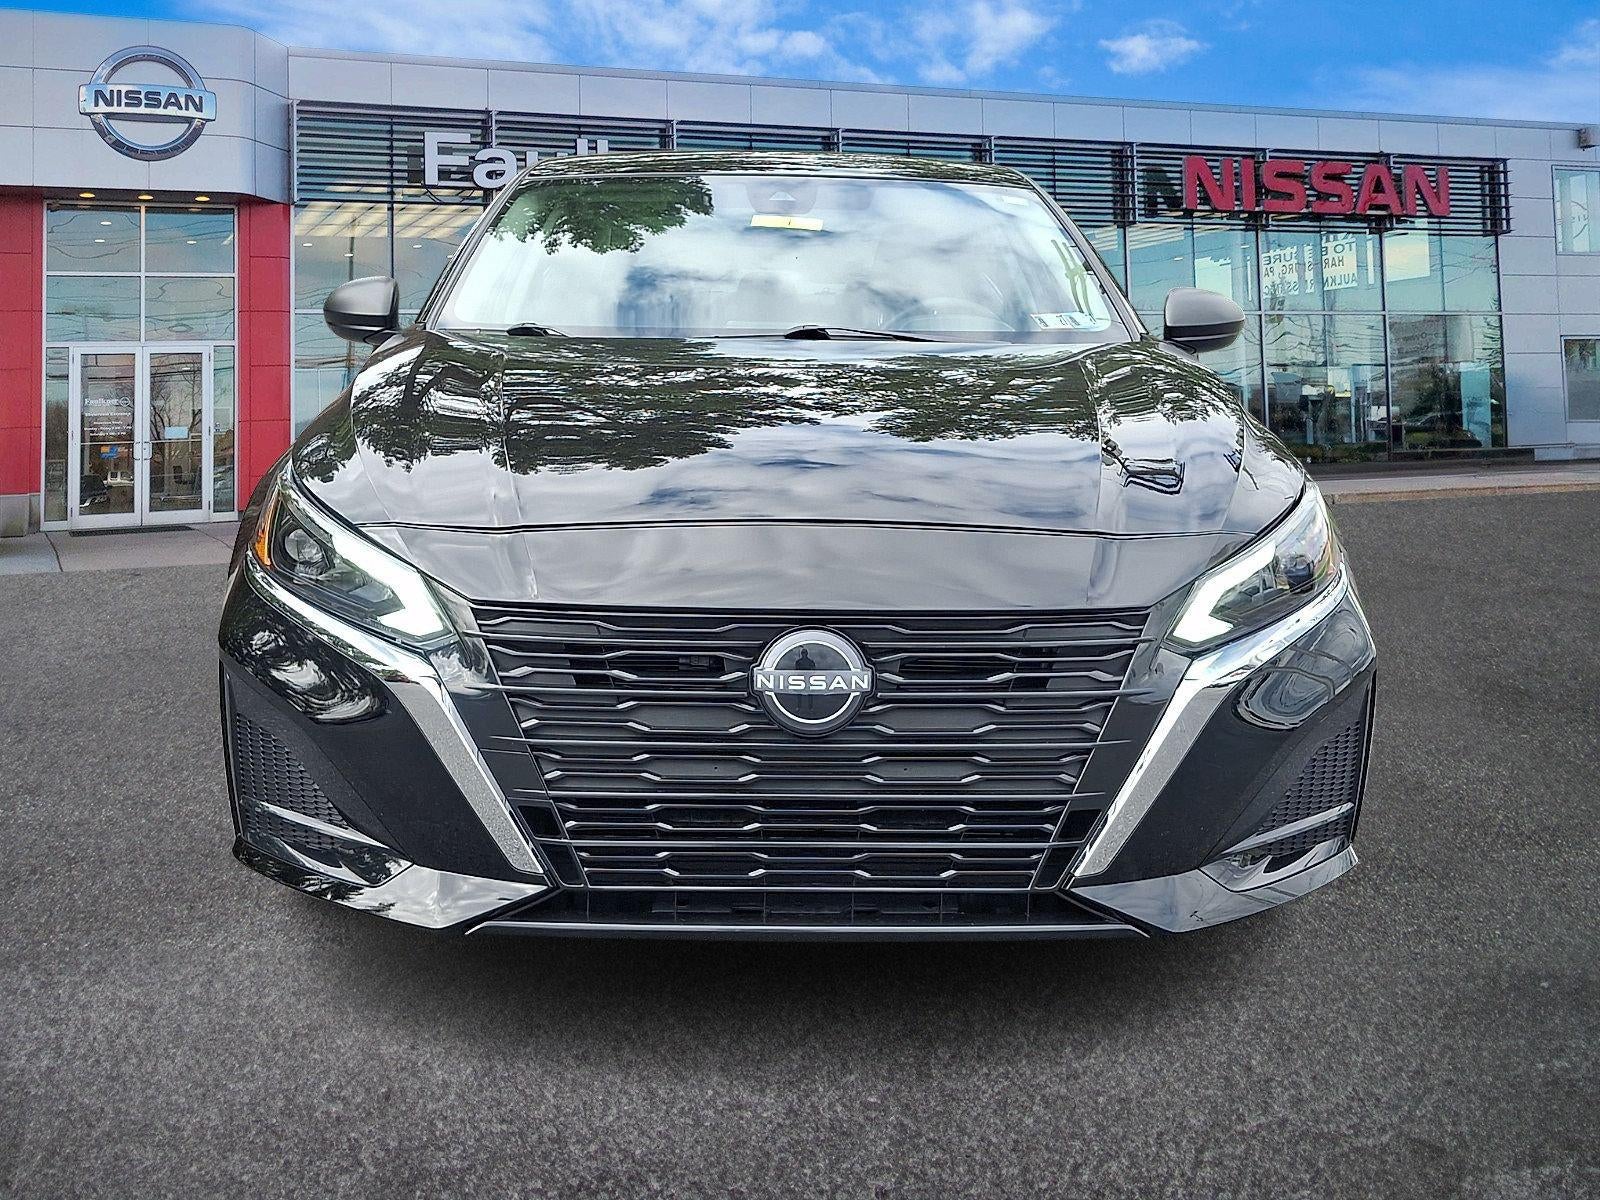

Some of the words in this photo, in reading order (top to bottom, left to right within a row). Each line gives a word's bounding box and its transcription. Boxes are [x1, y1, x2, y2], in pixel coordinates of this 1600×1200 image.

[93, 88, 204, 113] NISSAN
[1181, 155, 1450, 217] NISSAN
[756, 673, 869, 690] NISSAN
